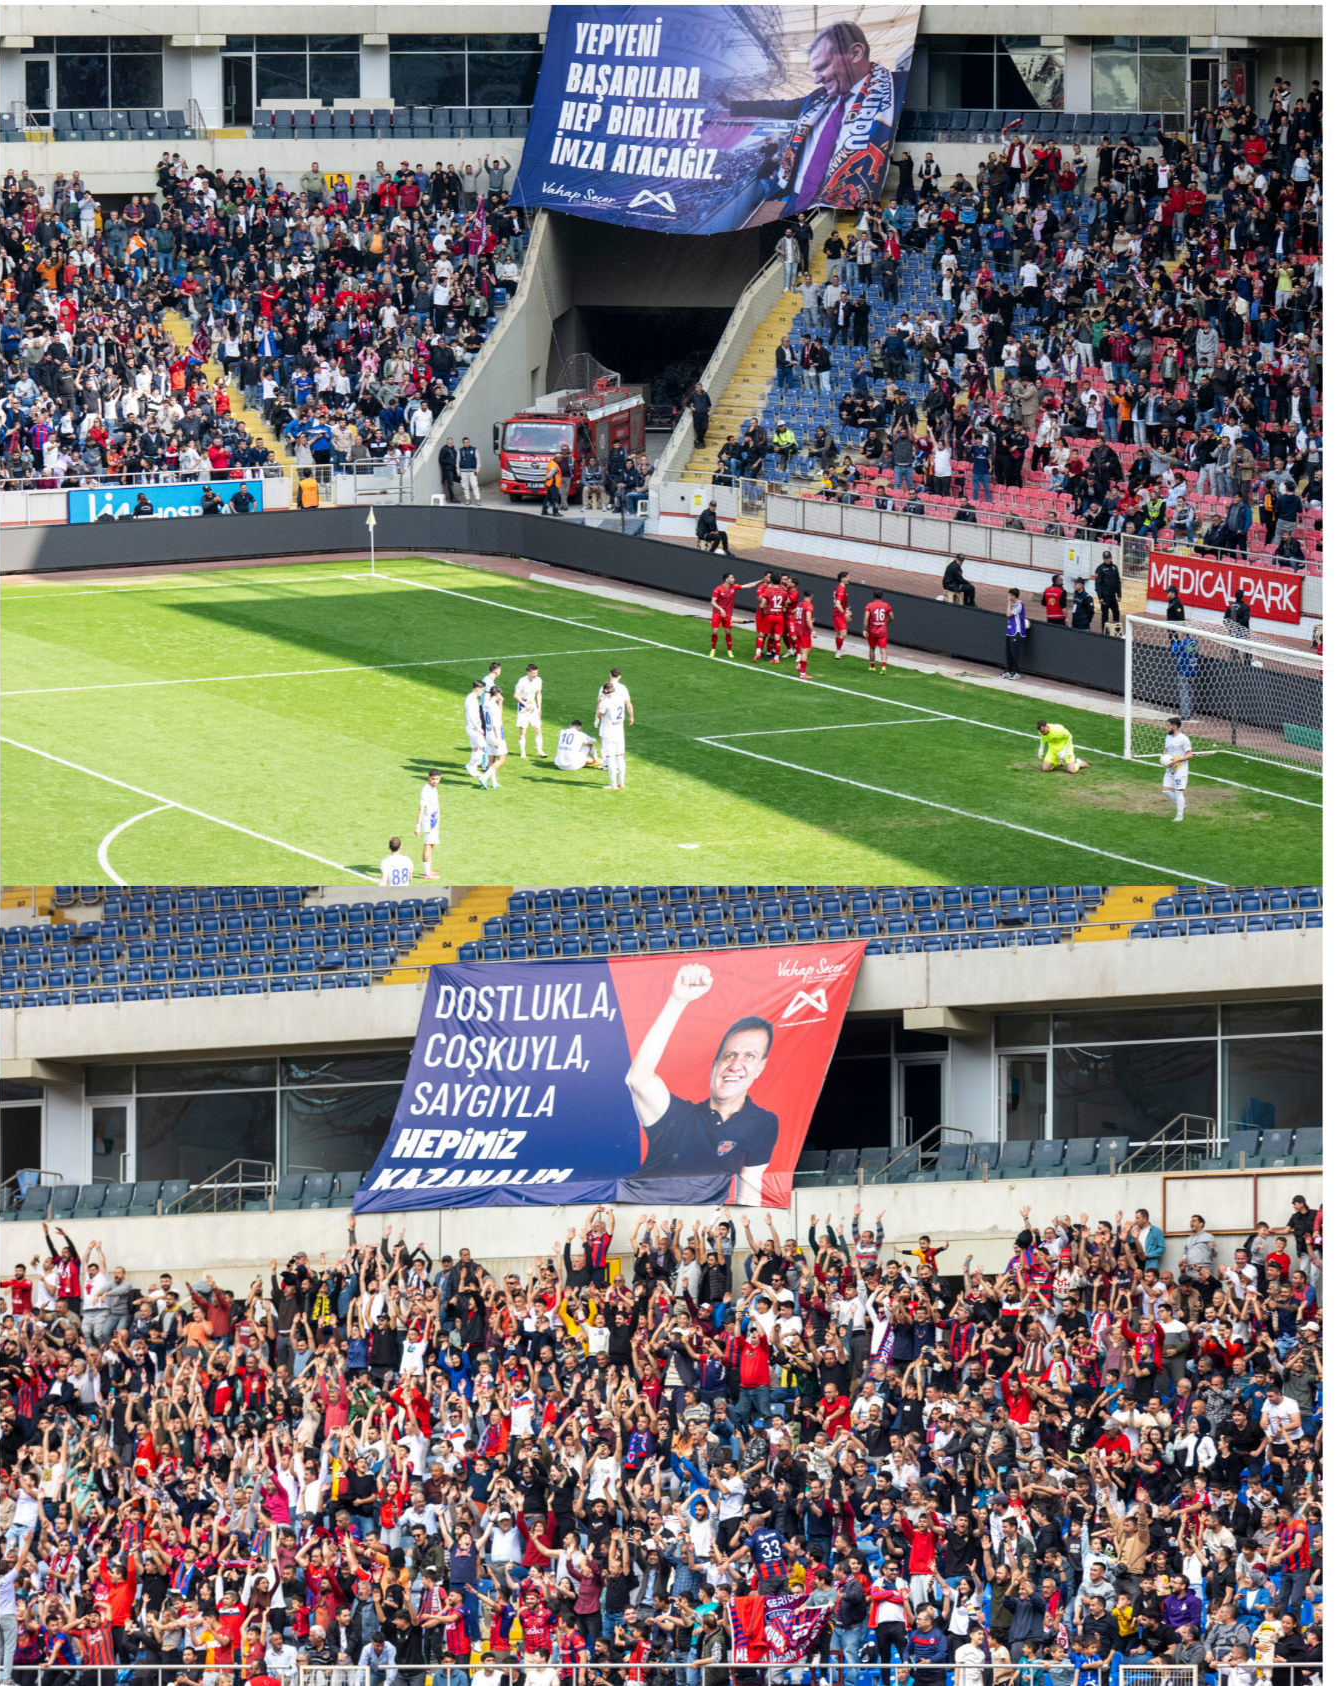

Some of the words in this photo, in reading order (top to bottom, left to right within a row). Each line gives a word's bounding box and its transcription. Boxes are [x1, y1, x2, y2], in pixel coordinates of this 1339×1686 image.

[575, 16, 663, 57] YEPYENİ
[565, 62, 701, 103] BAŞARILARA
[557, 100, 603, 132] HEP
[606, 99, 705, 139] BİRLİKTE
[550, 130, 607, 171] İMZA
[610, 141, 722, 181] ATACAĞIZ.
[771, 595, 783, 609] 12
[873, 608, 886, 622] 16
[561, 732, 575, 746] 10
[391, 867, 409, 886] 88
[1132, 896, 1144, 904] 04
[468, 915, 478, 923] 05
[778, 958, 815, 984] Vahap
[435, 982, 617, 1022] DOSTLUKLA,
[423, 1032, 591, 1078] COŞKUYLA,
[410, 1081, 556, 1118] SAYGIYLA
[390, 1127, 528, 1160] HEPİMİZ
[760, 1539, 782, 1559] 33
